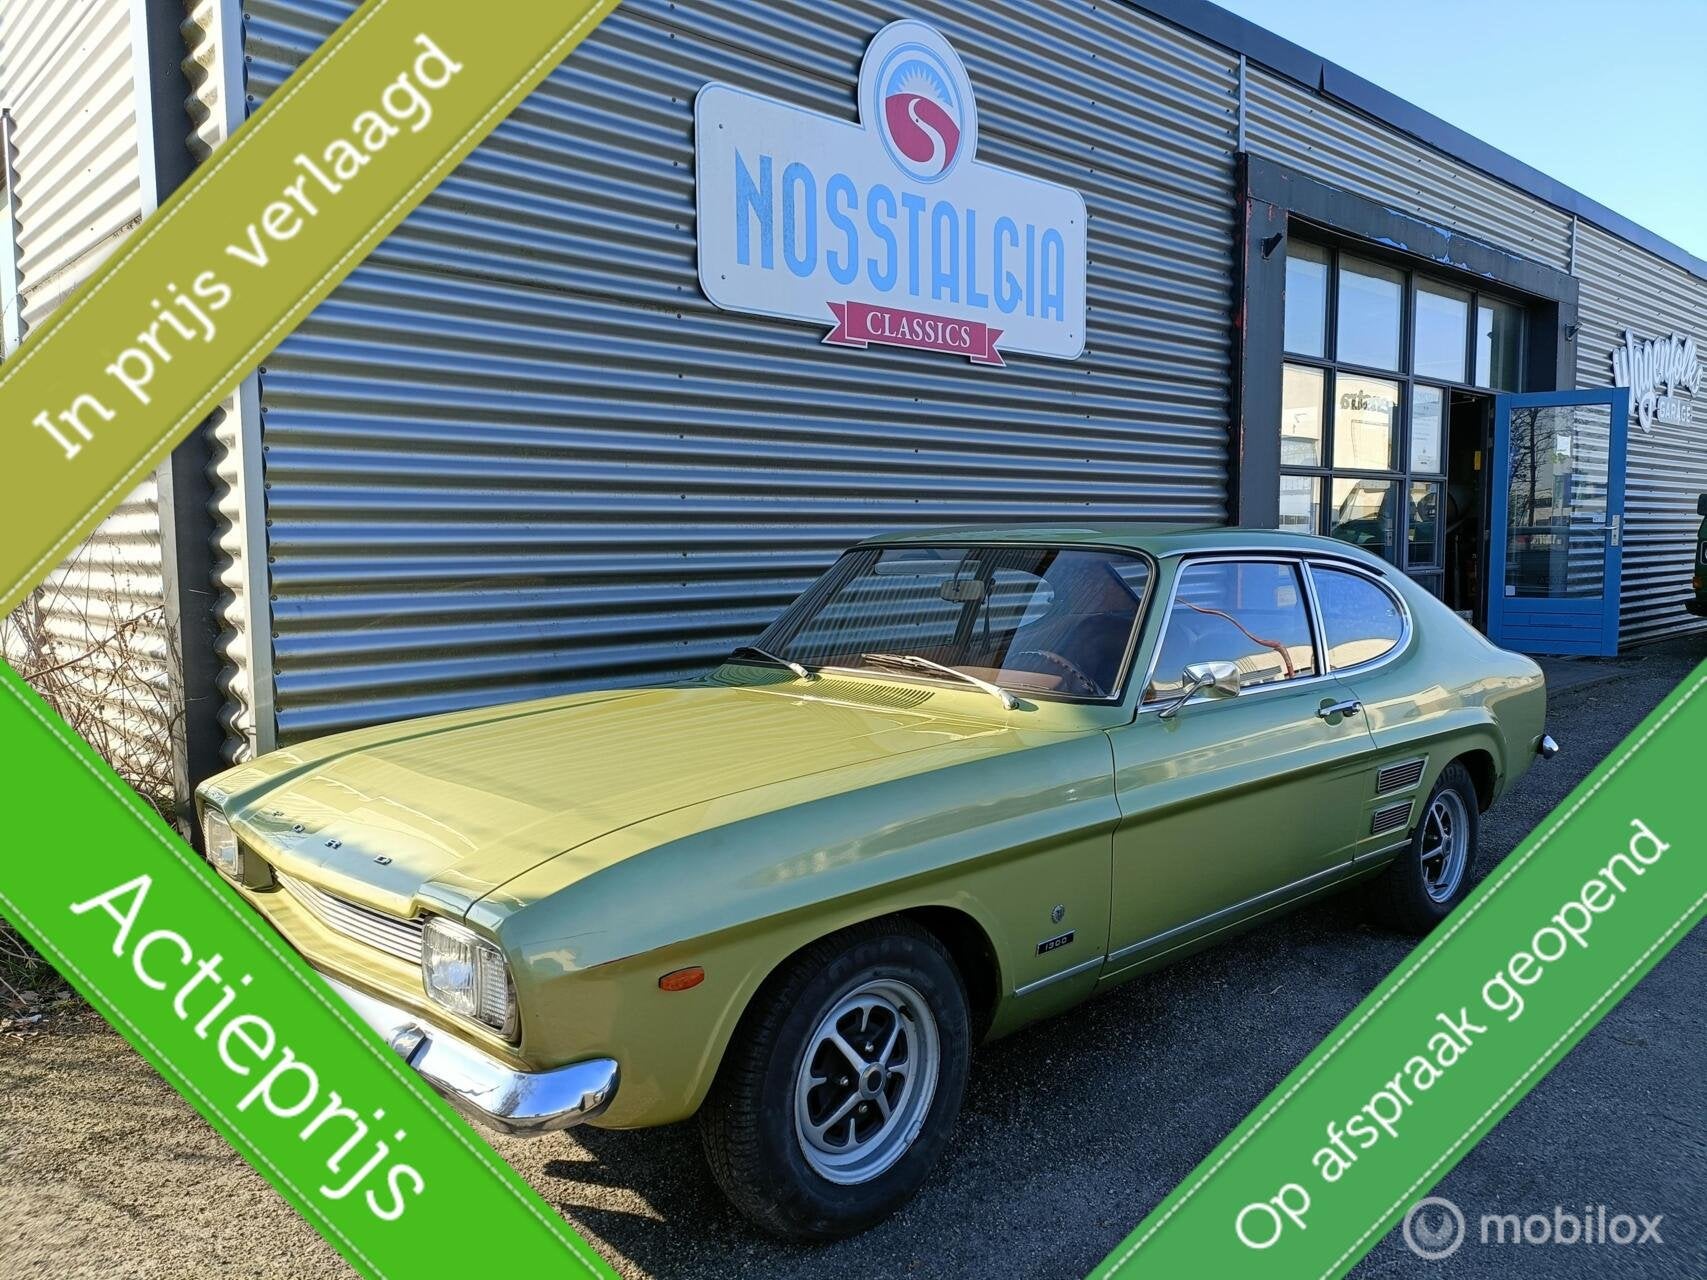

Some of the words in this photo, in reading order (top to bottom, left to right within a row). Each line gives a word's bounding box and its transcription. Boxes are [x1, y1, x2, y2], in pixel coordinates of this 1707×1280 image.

[734, 147, 1065, 322] NOSSTALGIA
[866, 311, 971, 348] CLASSICS
[1045, 937, 1068, 951] 1300
